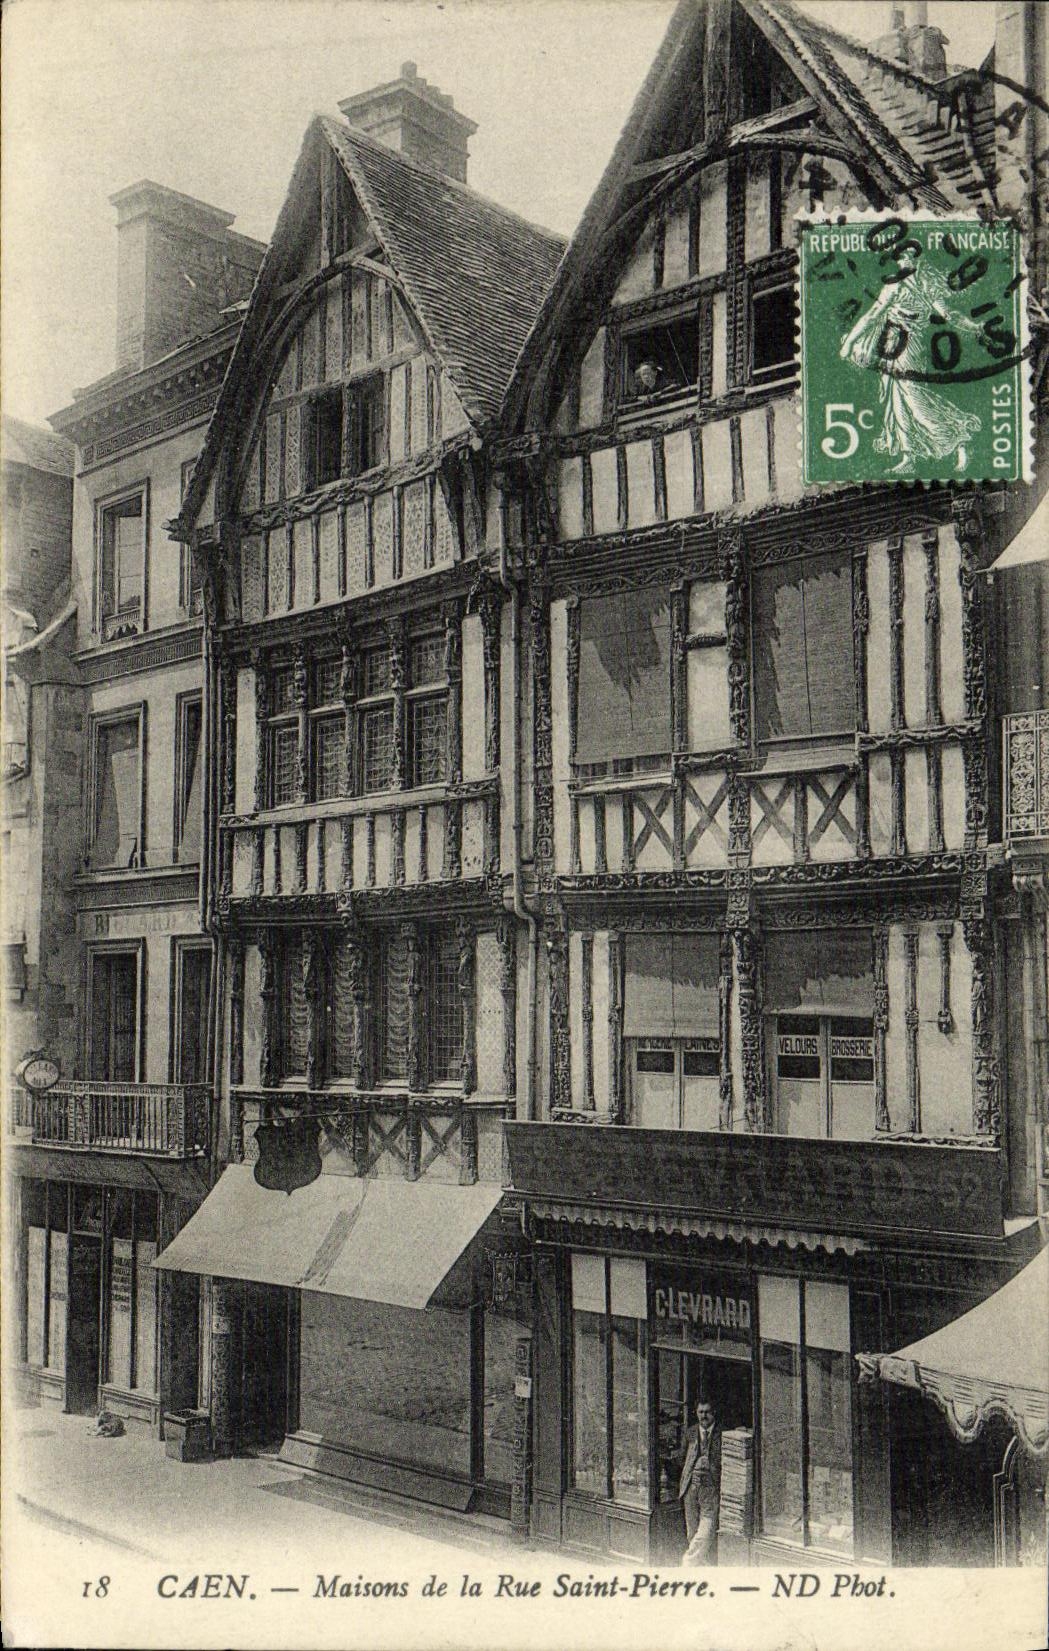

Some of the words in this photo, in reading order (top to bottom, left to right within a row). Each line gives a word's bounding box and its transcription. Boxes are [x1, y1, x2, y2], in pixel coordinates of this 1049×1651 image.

[992, 383, 1012, 469] POSTES
[779, 1037, 818, 1055] VELOURS
[831, 1038, 873, 1058] BROSSERIE
